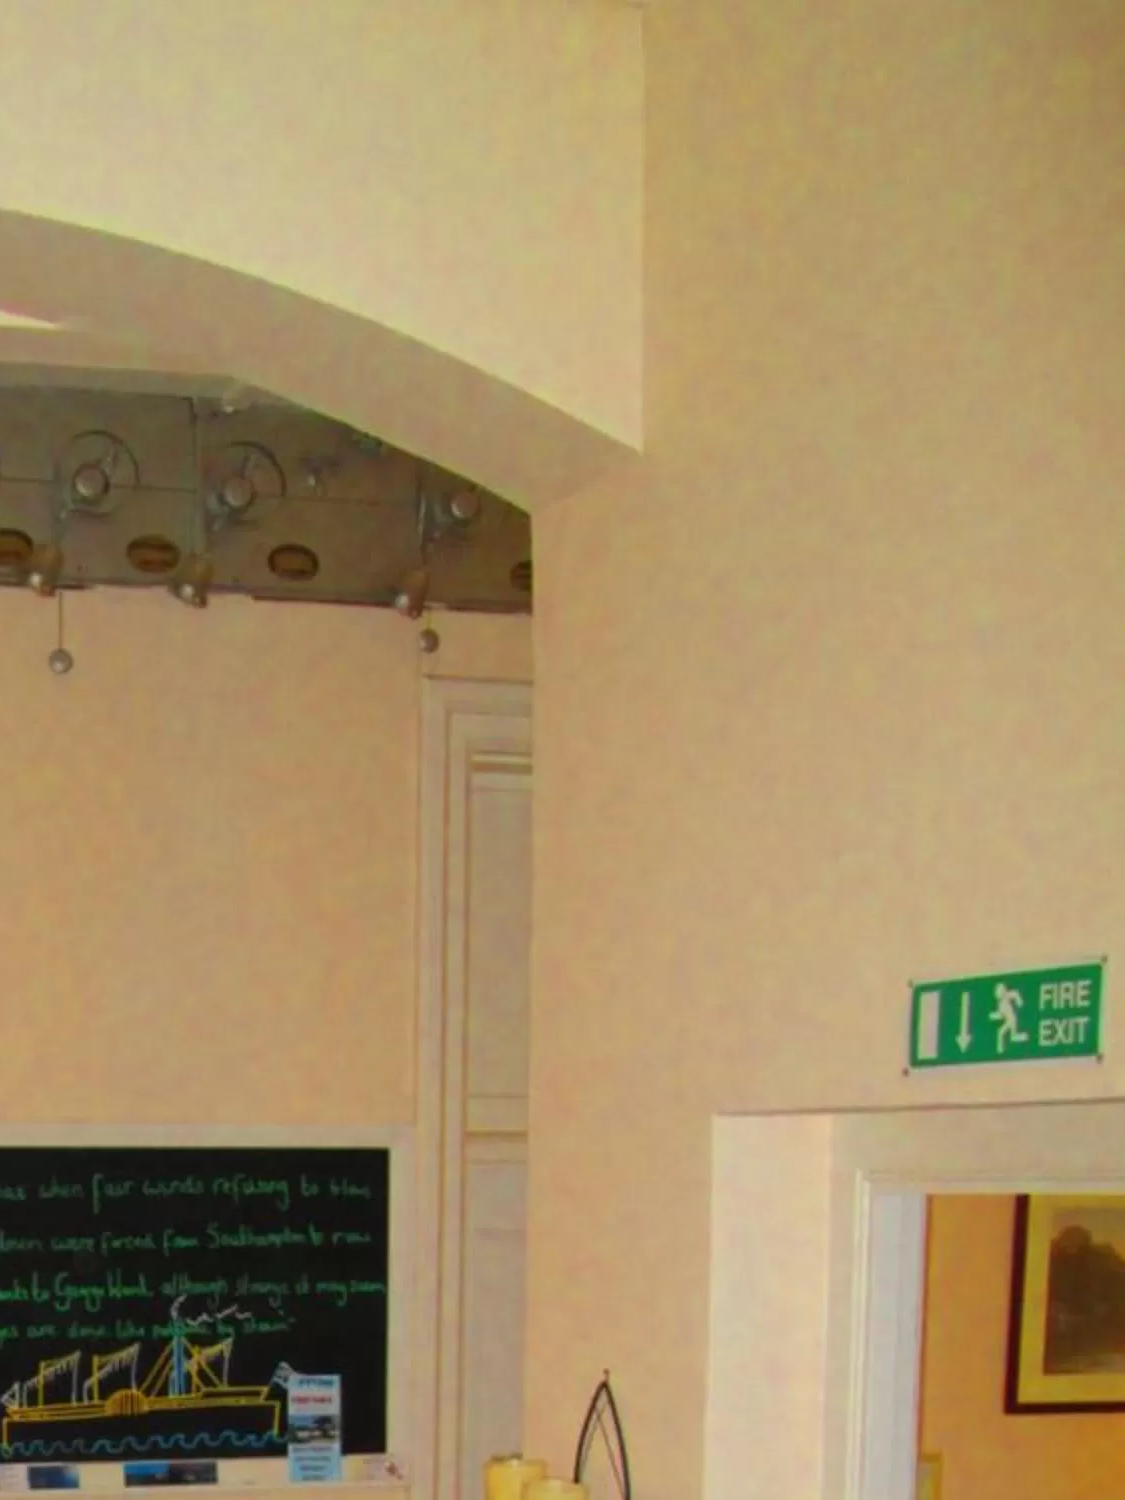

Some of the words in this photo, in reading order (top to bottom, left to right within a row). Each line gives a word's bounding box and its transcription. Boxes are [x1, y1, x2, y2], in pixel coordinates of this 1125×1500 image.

[1038, 980, 1092, 1010] FIRE
[1037, 1016, 1091, 1047] EXIT
[91, 1172, 135, 1214] fair
[141, 1176, 203, 1197] winds
[212, 1173, 290, 1211] refusing
[300, 1173, 319, 1197] to
[31, 1270, 51, 1303] to
